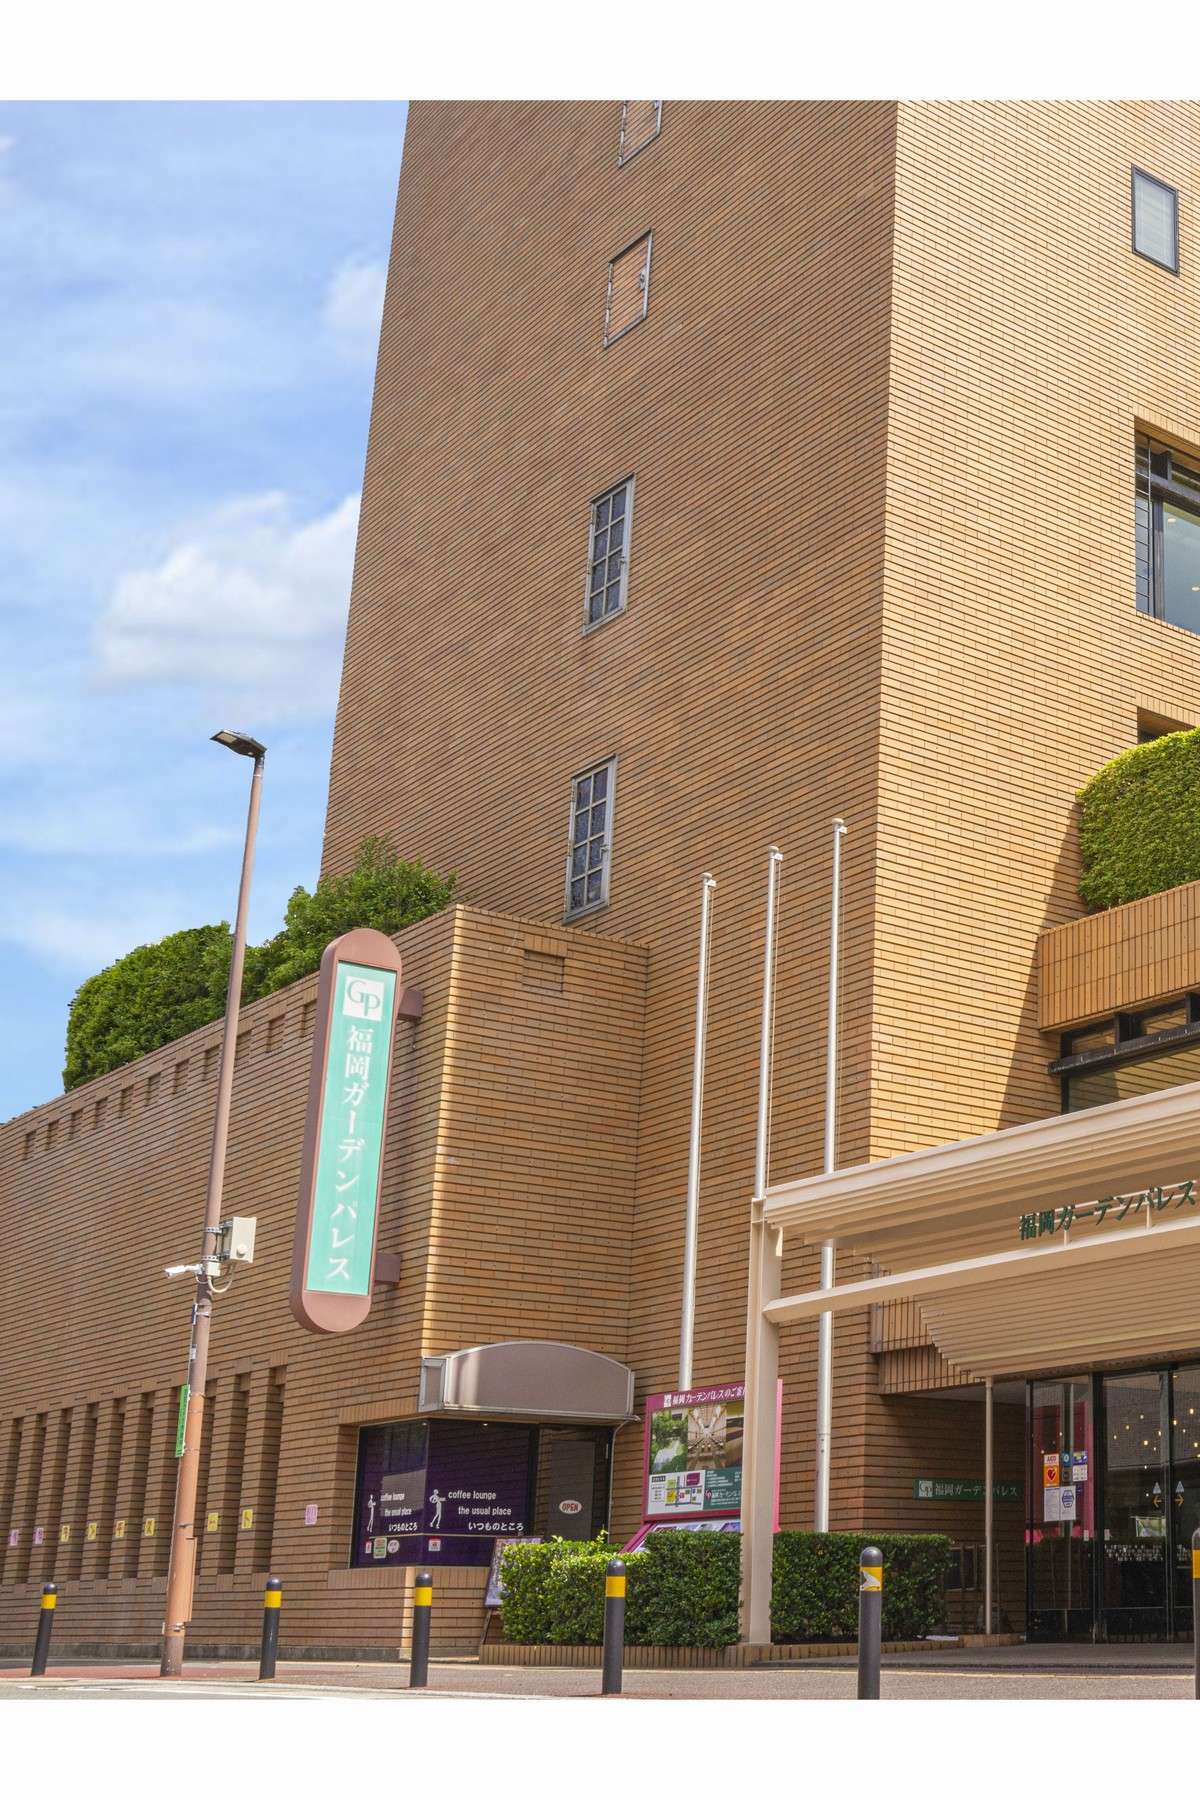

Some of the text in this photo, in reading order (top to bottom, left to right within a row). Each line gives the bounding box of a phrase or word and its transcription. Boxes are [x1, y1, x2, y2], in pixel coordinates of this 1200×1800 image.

[326, 1025, 374, 1281] 福岡ガーデンパレス
[1019, 1180, 1196, 1240] 福岡ガーデンパレス
[672, 1385, 746, 1406] 福岡ガーデンパレスのご案
[448, 1490, 497, 1501] coffee lounge
[458, 1505, 512, 1517] the usual place
[561, 1502, 579, 1512] OPEN
[468, 1522, 524, 1532] いつものところ
